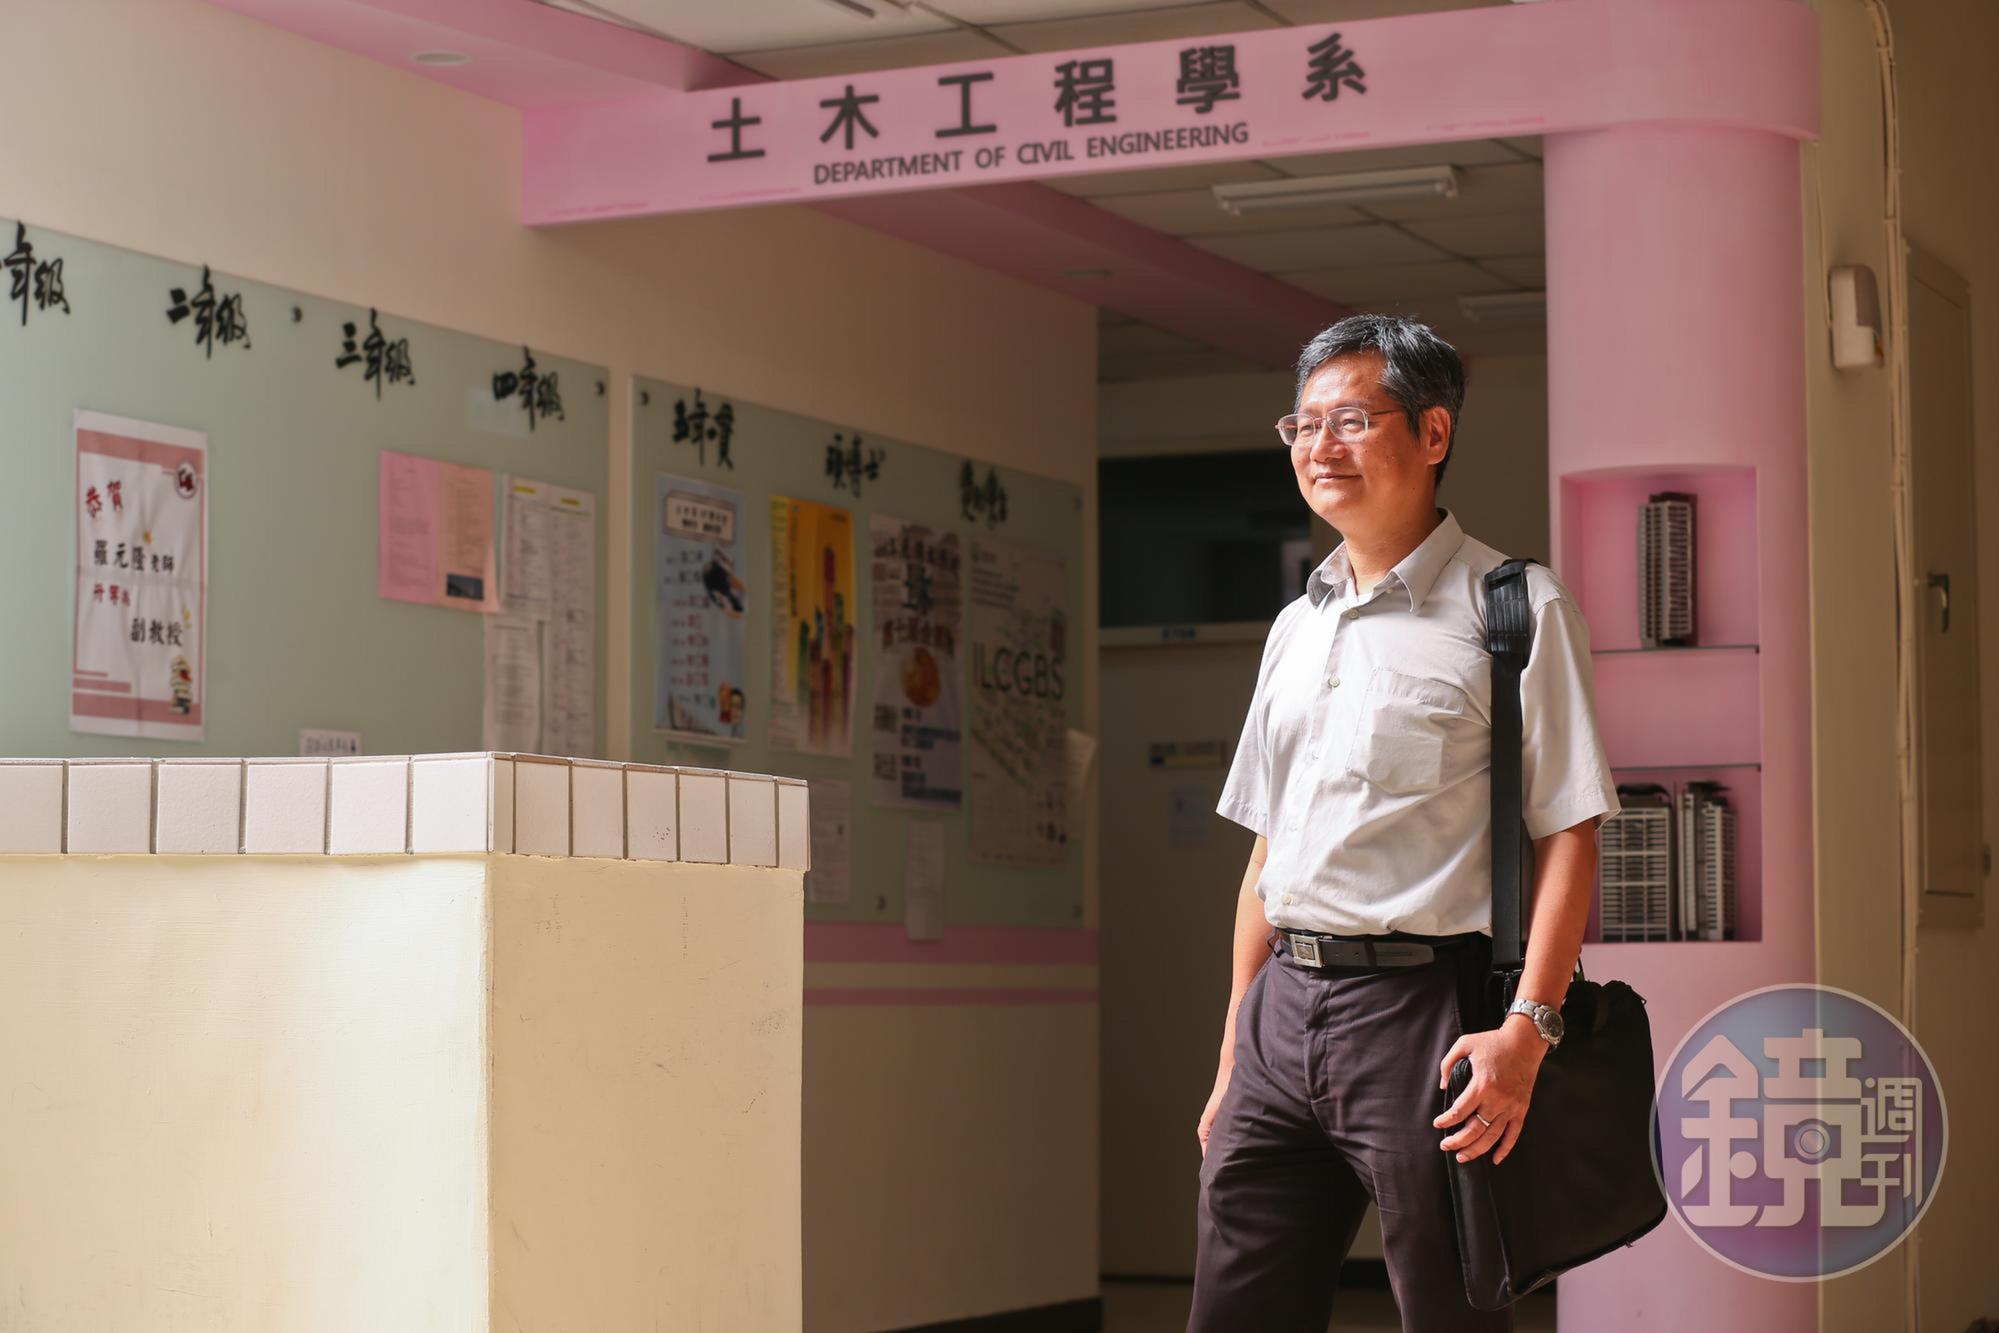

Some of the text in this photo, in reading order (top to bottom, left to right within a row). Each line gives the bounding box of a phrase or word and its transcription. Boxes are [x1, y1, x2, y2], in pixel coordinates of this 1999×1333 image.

[707, 32, 1368, 163] 土木工程學系
[813, 122, 1250, 185] DEPARTMENT OF CIVIL ENGINEERING
[166, 264, 251, 360] 二年級
[336, 307, 416, 401] 三年級
[492, 345, 565, 432] 四年級
